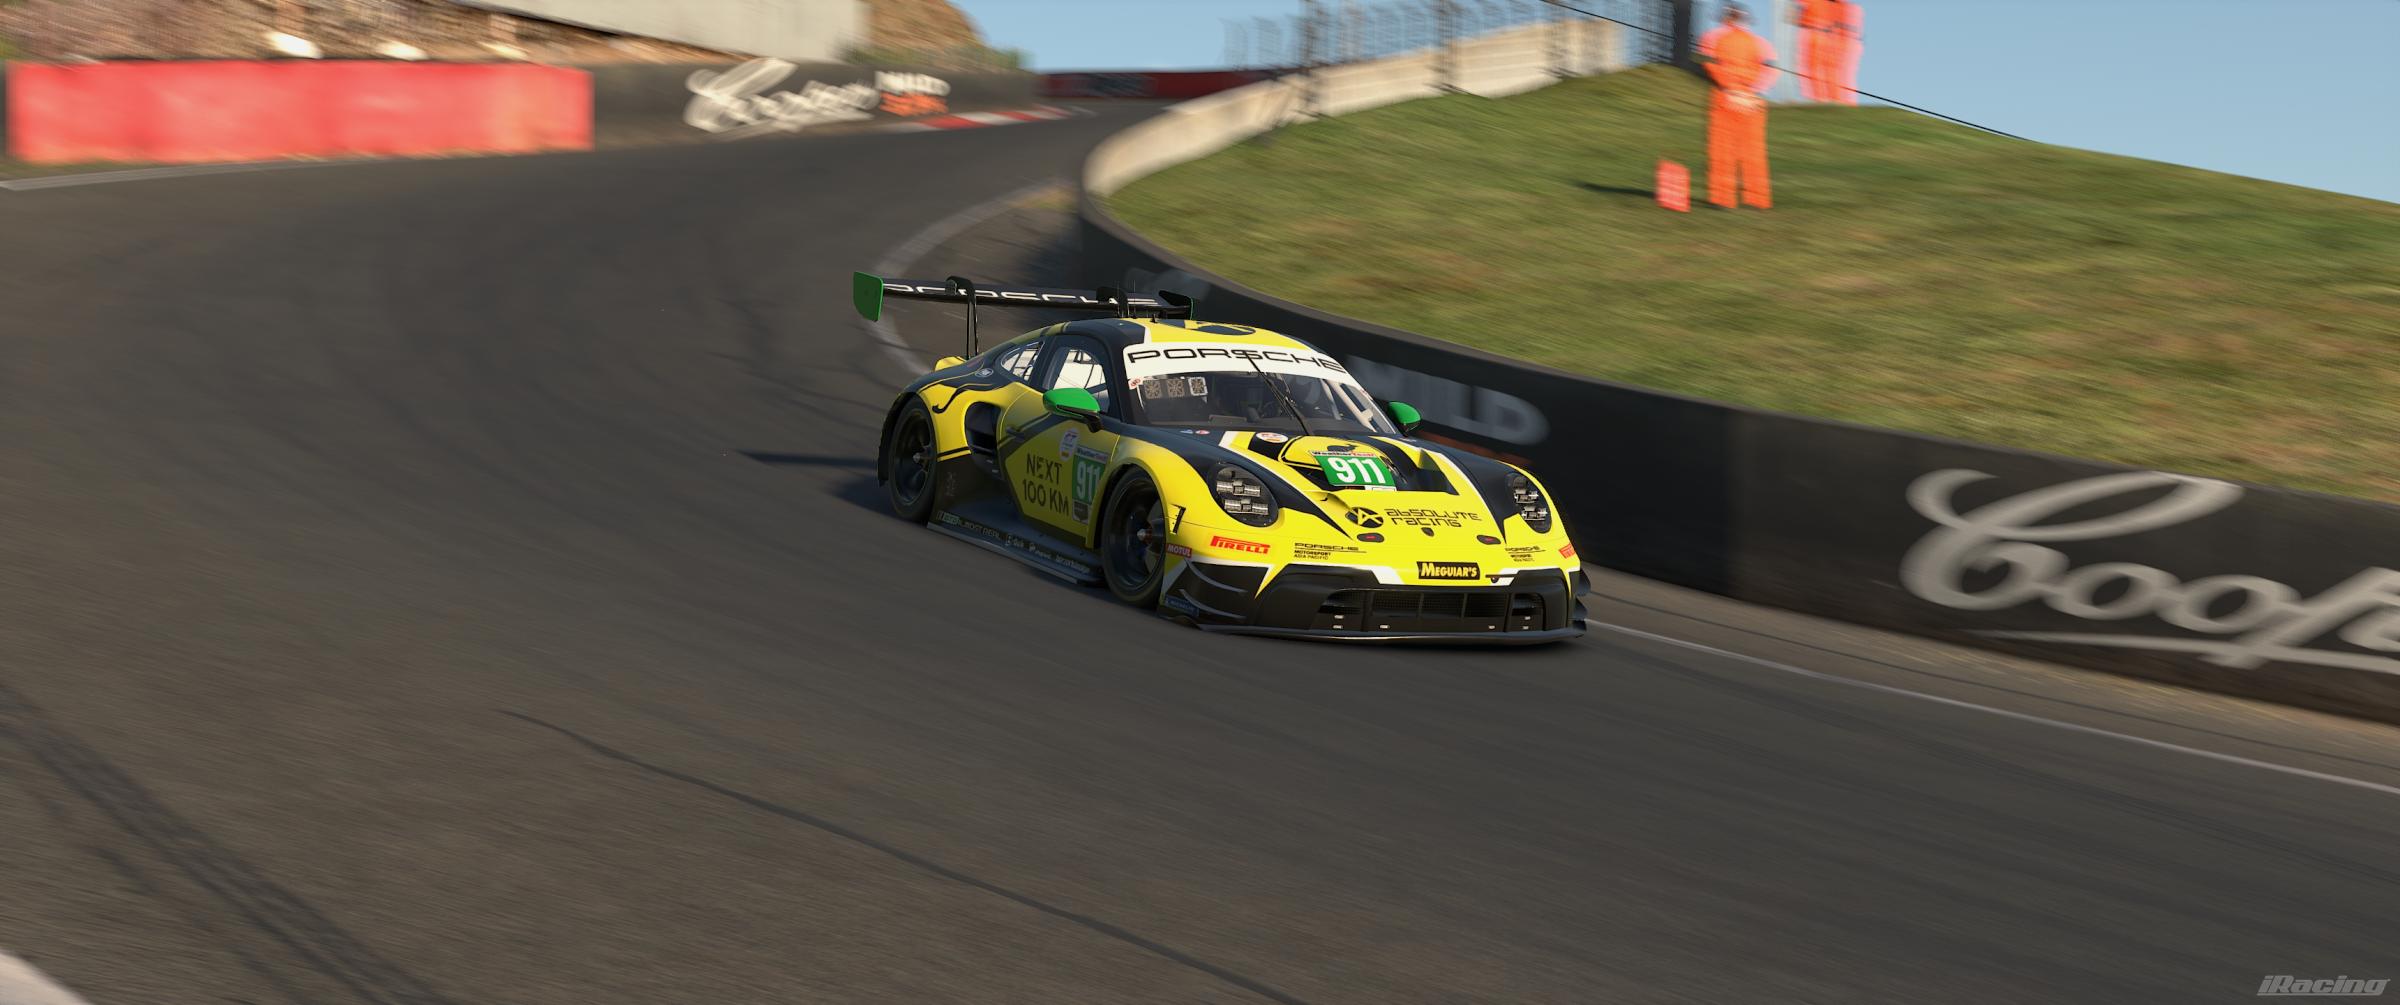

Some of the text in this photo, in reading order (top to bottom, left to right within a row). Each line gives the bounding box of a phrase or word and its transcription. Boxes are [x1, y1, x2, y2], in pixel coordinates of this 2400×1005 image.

[1127, 348, 1347, 374] PORSCHE
[1026, 453, 1063, 485] NEXT
[1076, 461, 1100, 502] 911
[1327, 457, 1387, 484] 911
[1023, 480, 1046, 507] 100
[1050, 488, 1070, 517] KM
[1167, 544, 1191, 557] MOTUL
[1210, 535, 1271, 555] PIRELLI
[1294, 542, 1360, 551] PORSCHE
[1420, 562, 1478, 578] MEGUIAR'S
